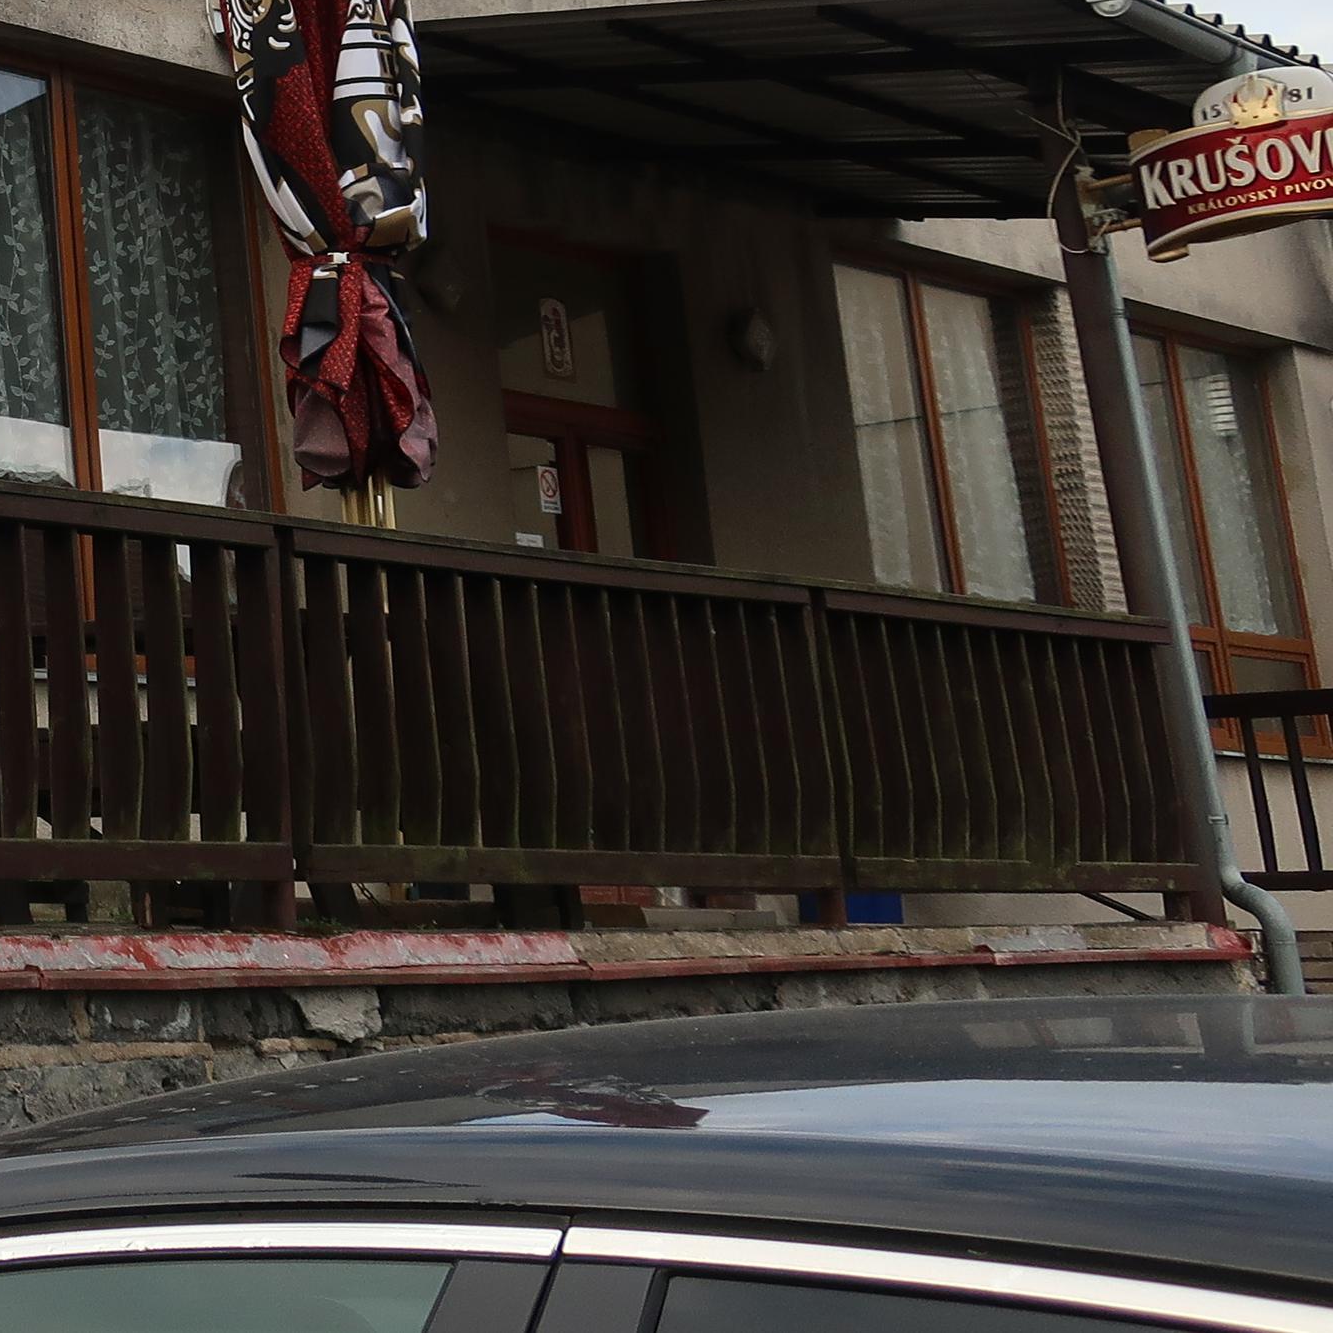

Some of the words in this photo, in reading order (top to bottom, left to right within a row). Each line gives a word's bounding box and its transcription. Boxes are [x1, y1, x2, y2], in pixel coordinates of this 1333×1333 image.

[1202, 103, 1222, 120] 15
[1288, 87, 1313, 103] 81
[1188, 185, 1278, 215] KRÁLOVSKÝ
